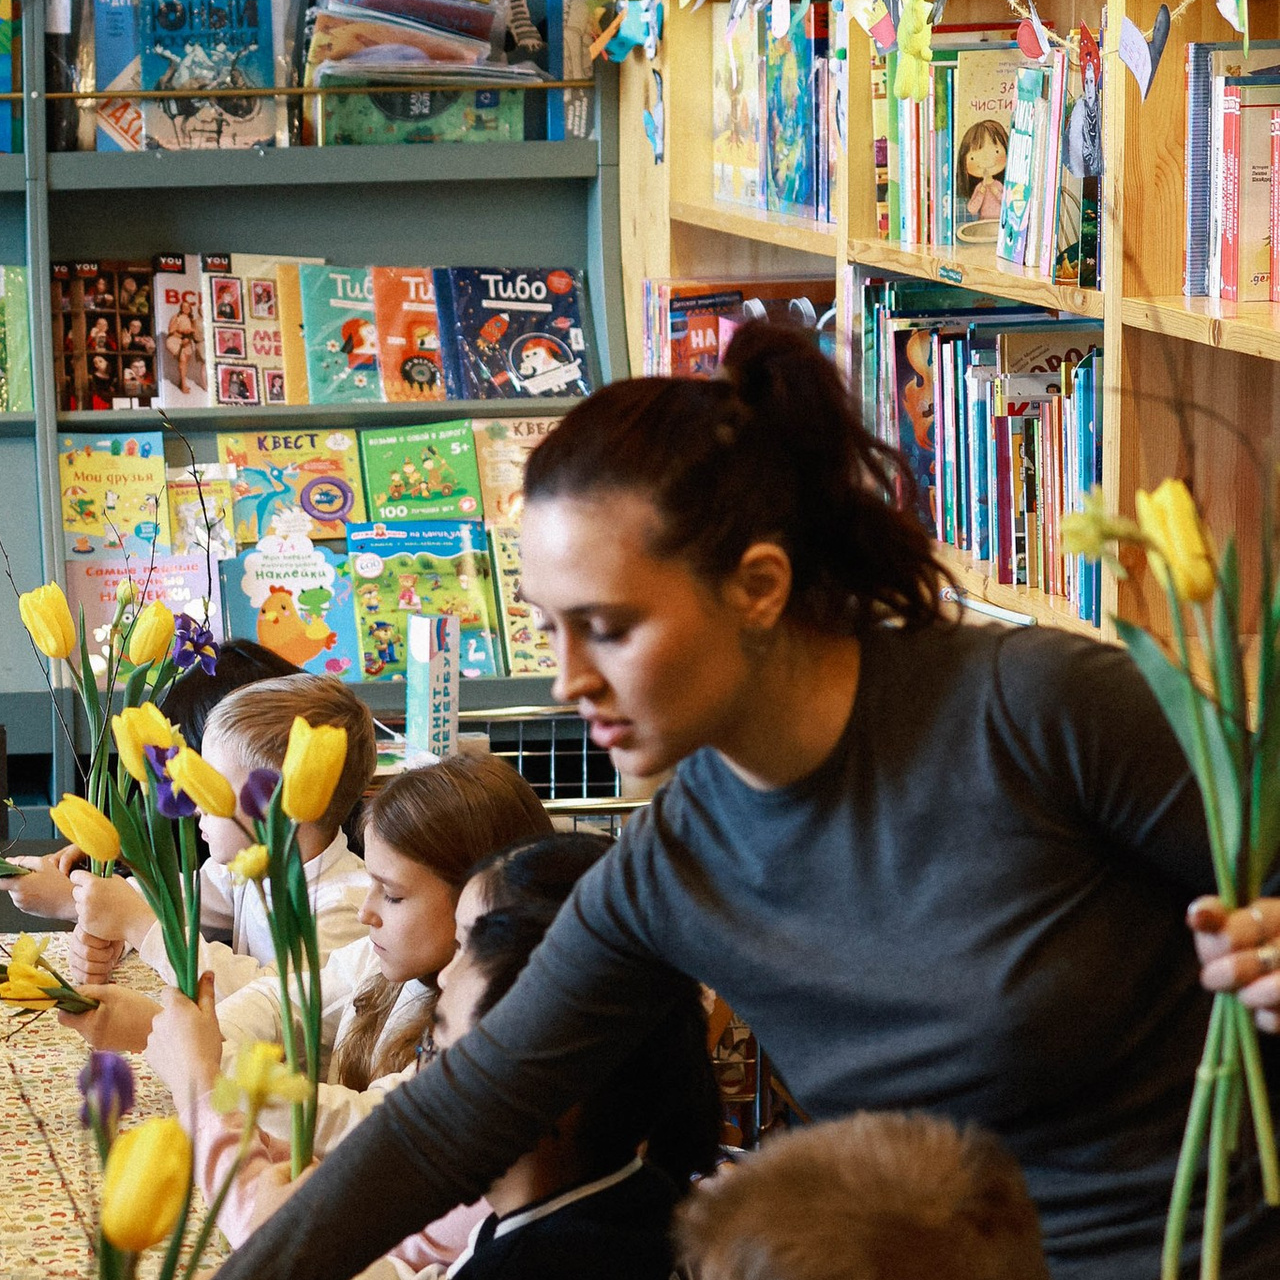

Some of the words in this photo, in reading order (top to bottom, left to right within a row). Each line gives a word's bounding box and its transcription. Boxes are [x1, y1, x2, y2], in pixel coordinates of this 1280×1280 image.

[971, 97, 1013, 112] ЧИСТИ
[75, 262, 98, 271] YOU
[160, 255, 182, 265] YOU
[205, 255, 228, 265] YOU
[54, 264, 68, 272] YO
[329, 273, 374, 298] Тиб
[401, 275, 435, 300] Ти
[480, 273, 547, 300] Тибо
[257, 432, 319, 451] КВЕСТ
[449, 441, 470, 455] 5+
[73, 471, 101, 483] Мои
[106, 473, 154, 486] друзья
[379, 505, 408, 519] 100
[86, 565, 137, 578] Самые
[255, 570, 328, 581] Наклейки
[100, 587, 191, 603] НАЛЕЙКИ
[432, 674, 442, 757] САНКТ-
